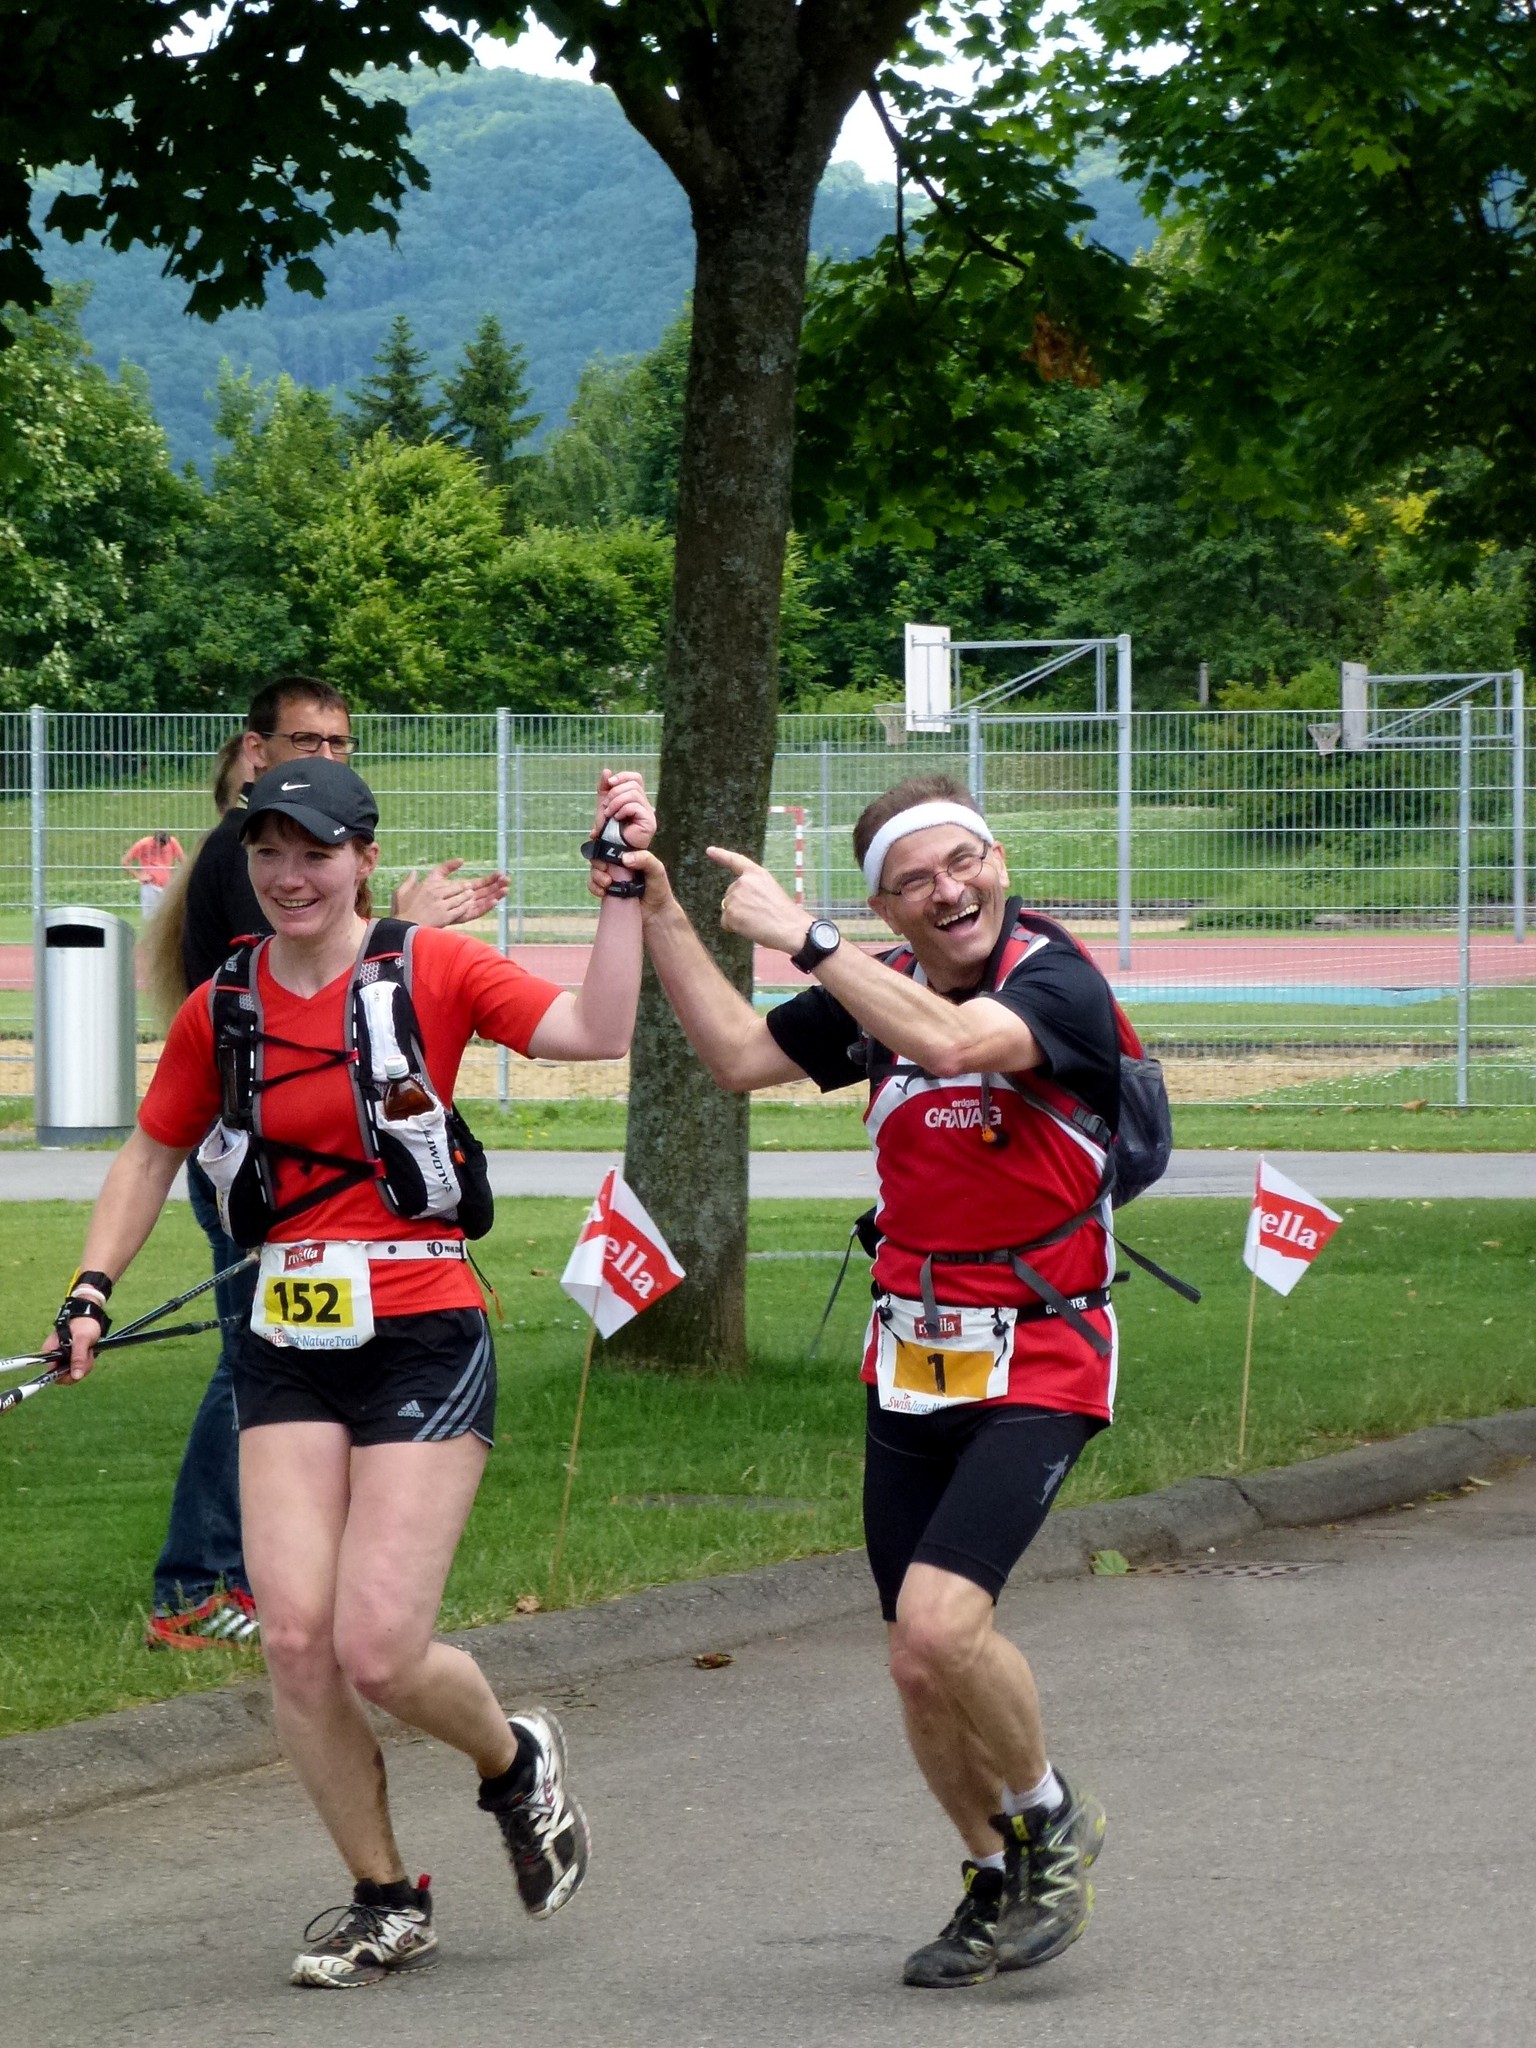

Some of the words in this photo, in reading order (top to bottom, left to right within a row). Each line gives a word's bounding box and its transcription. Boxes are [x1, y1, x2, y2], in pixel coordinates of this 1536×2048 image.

[1258, 1208, 1318, 1250] ella
[272, 1281, 342, 1324] 152
[918, 1317, 956, 1335] rilla
[926, 1352, 946, 1394] 1
[397, 1409, 425, 1419] adidas
